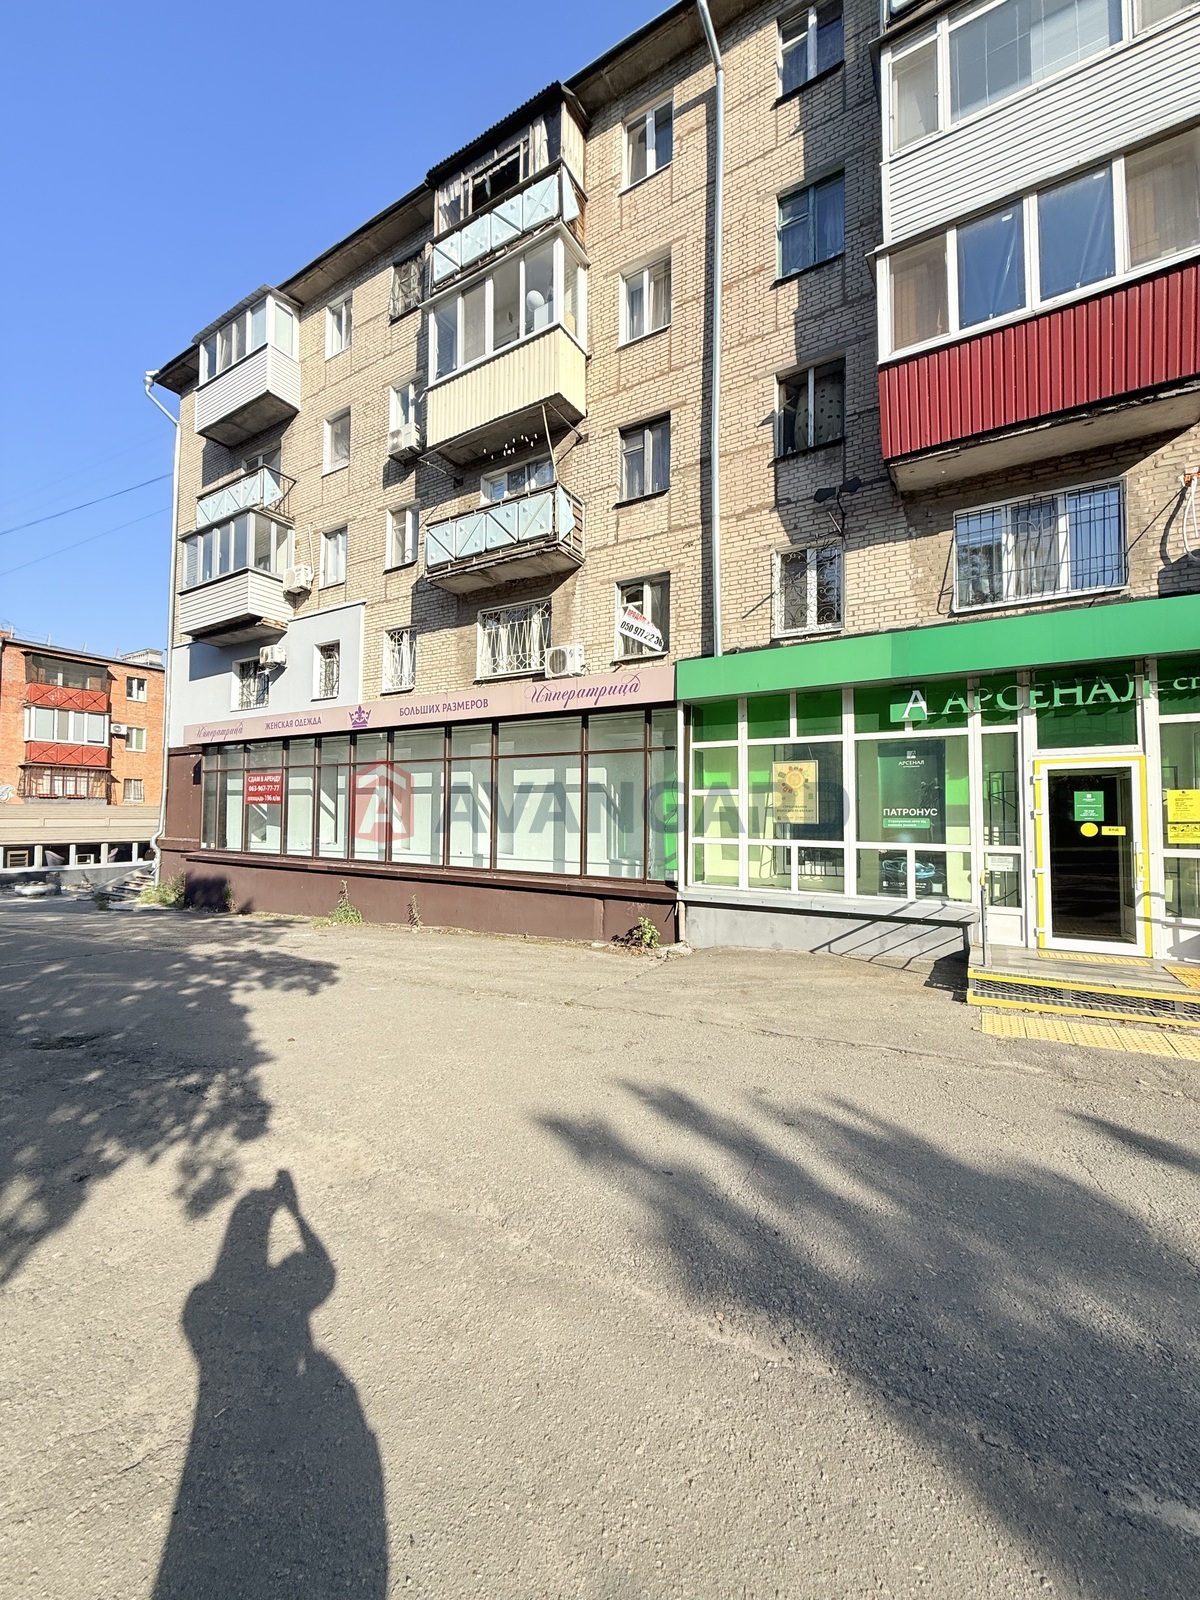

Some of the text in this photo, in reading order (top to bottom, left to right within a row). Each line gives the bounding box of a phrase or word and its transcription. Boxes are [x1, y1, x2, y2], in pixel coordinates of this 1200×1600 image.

[620, 621, 634, 632] 050
[633, 626, 645, 637] 977
[644, 631, 655, 642] 22
[525, 672, 642, 708] Императрица
[941, 674, 1152, 714] АРСЕНАЛ
[399, 698, 489, 717] БОЛЬШИХ РАЗМЕРОВ
[265, 720, 293, 731] ЖЕНСКАЯ
[295, 716, 321, 727] ОДЕЖДА
[883, 808, 938, 816] ПАТРОНУС
